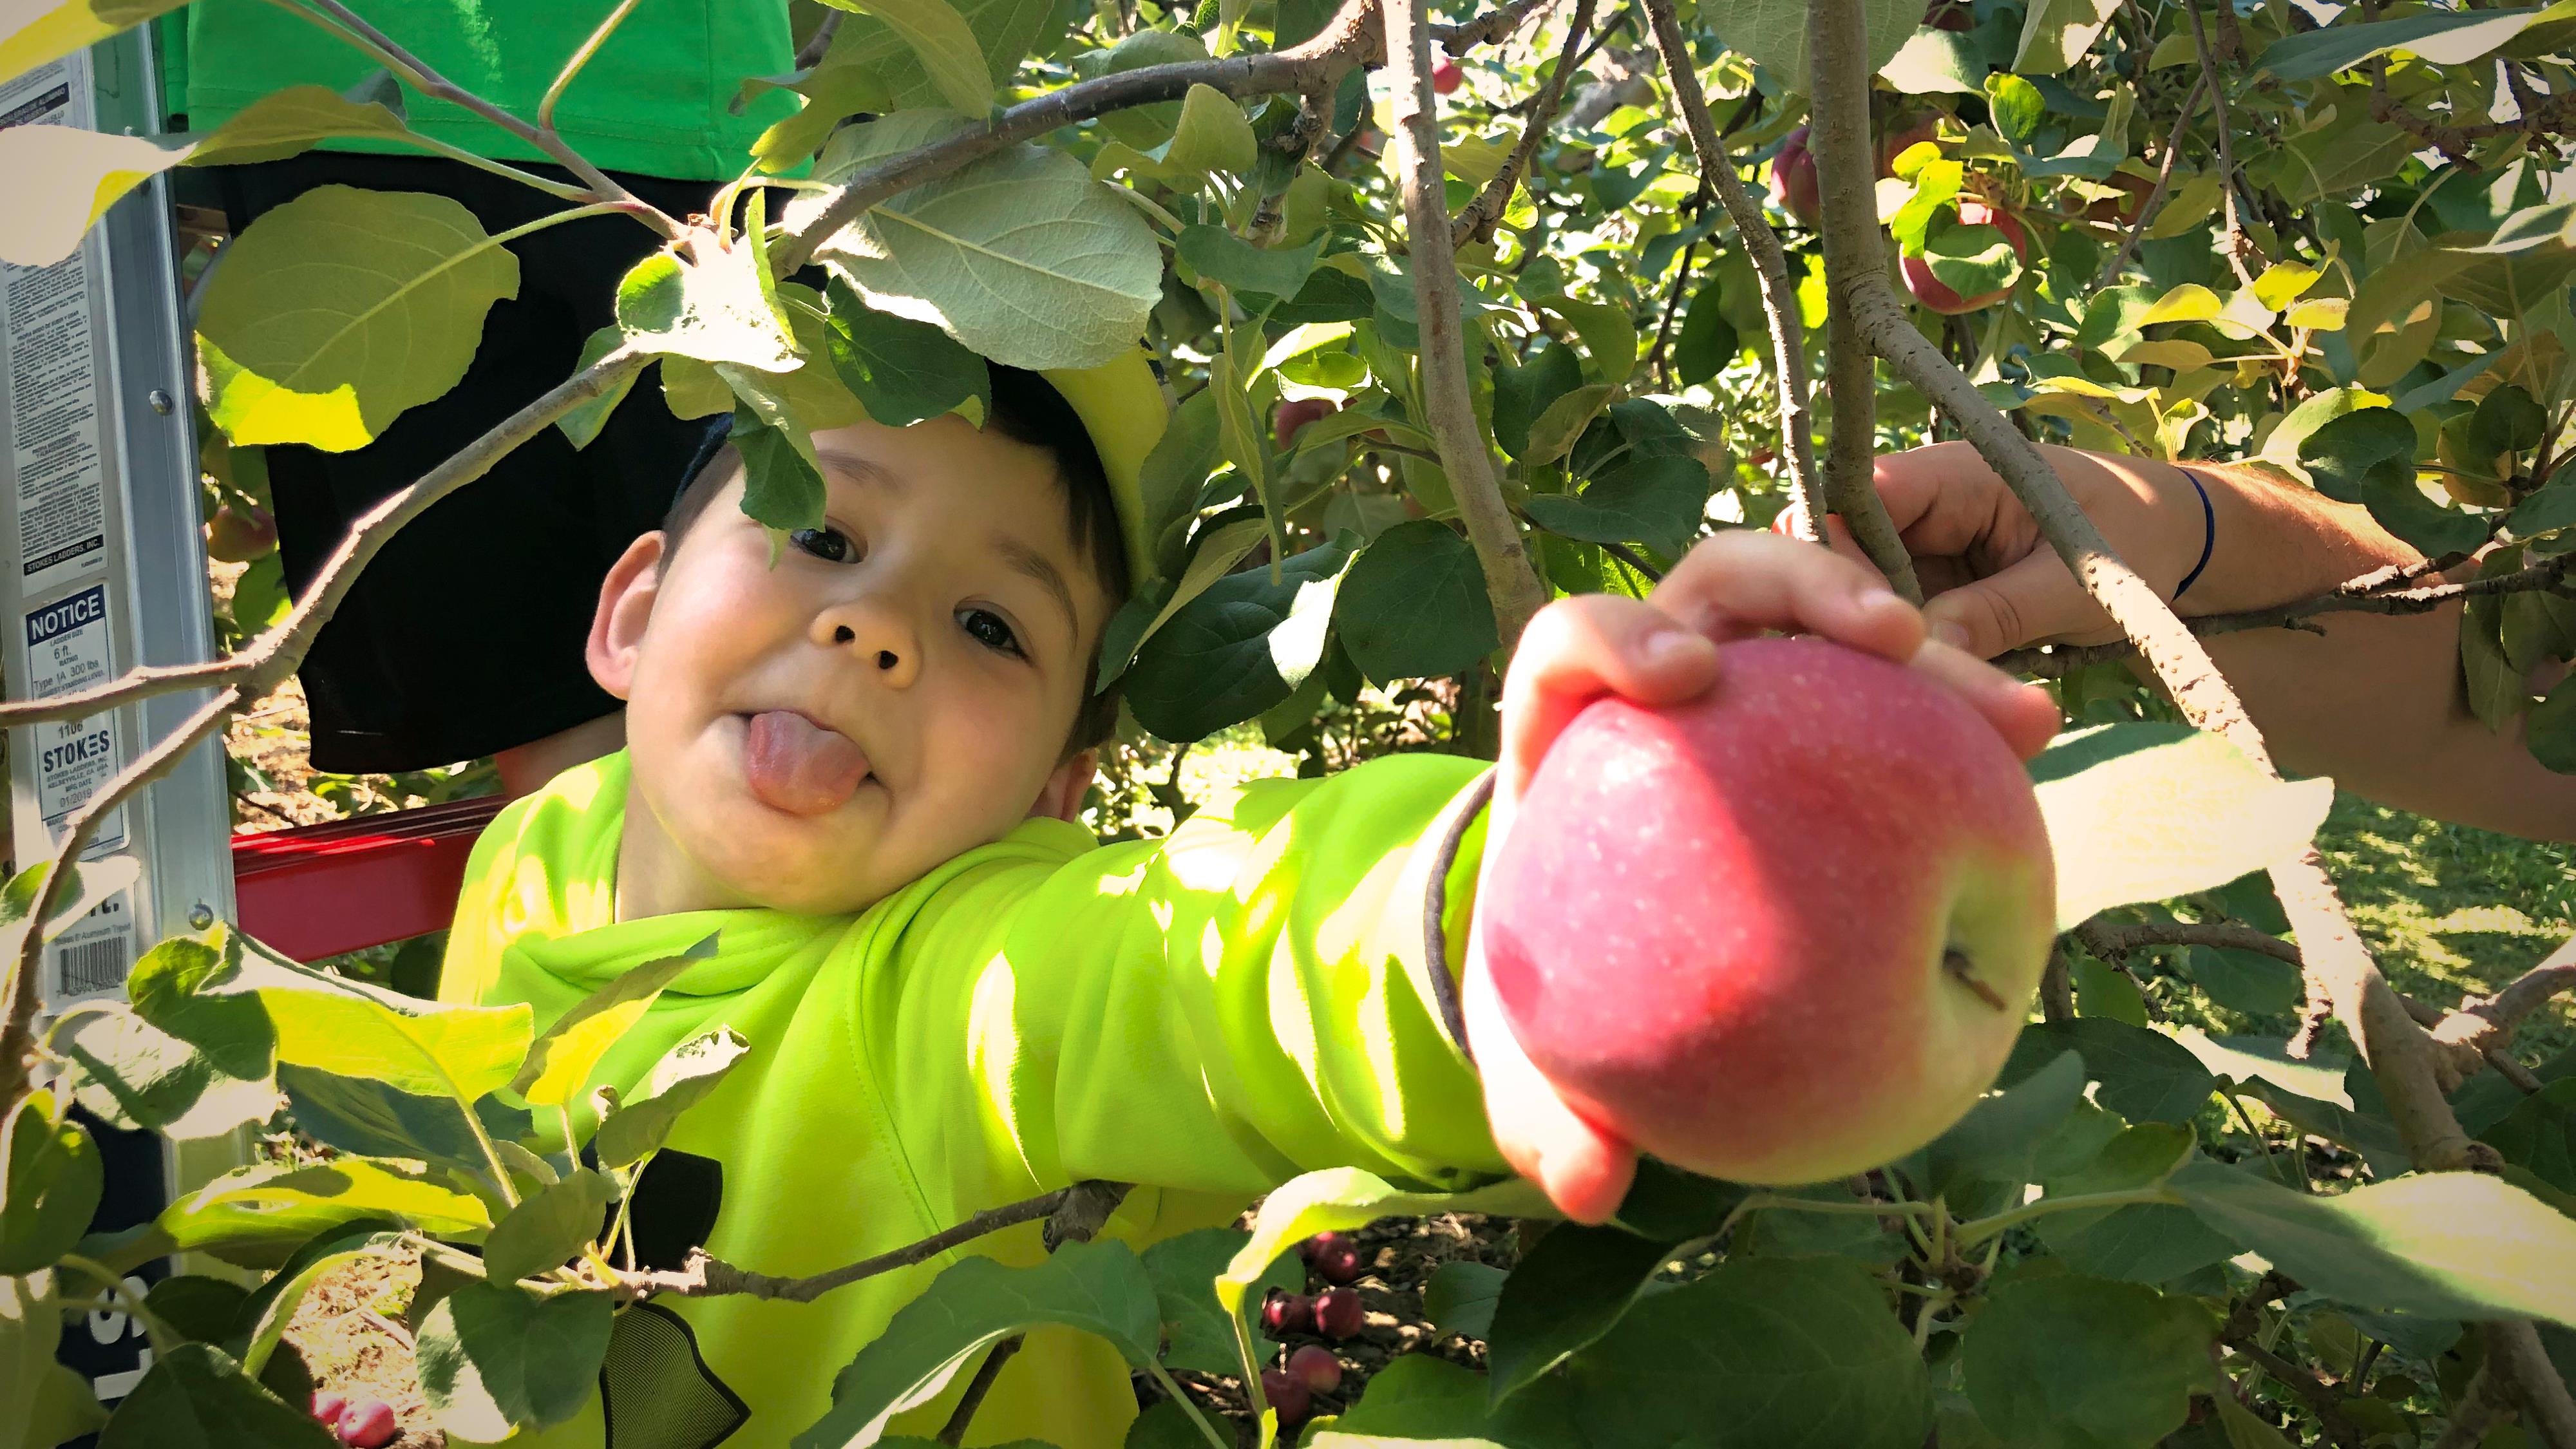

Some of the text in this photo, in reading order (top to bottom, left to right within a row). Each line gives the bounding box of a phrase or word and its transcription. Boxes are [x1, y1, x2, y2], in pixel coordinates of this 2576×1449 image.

[27, 556, 53, 573] STOKES
[86, 538, 100, 550] INC.
[32, 593, 101, 640] NOTICE
[50, 629, 84, 647] LADDER SIZE
[54, 645, 71, 660] 6 ft.
[59, 654, 79, 667] RATING
[33, 677, 53, 692] Type
[70, 663, 85, 677] 300
[44, 730, 110, 773] STOKES
[78, 778, 92, 787] DATE
[60, 788, 93, 808] 01/2019
